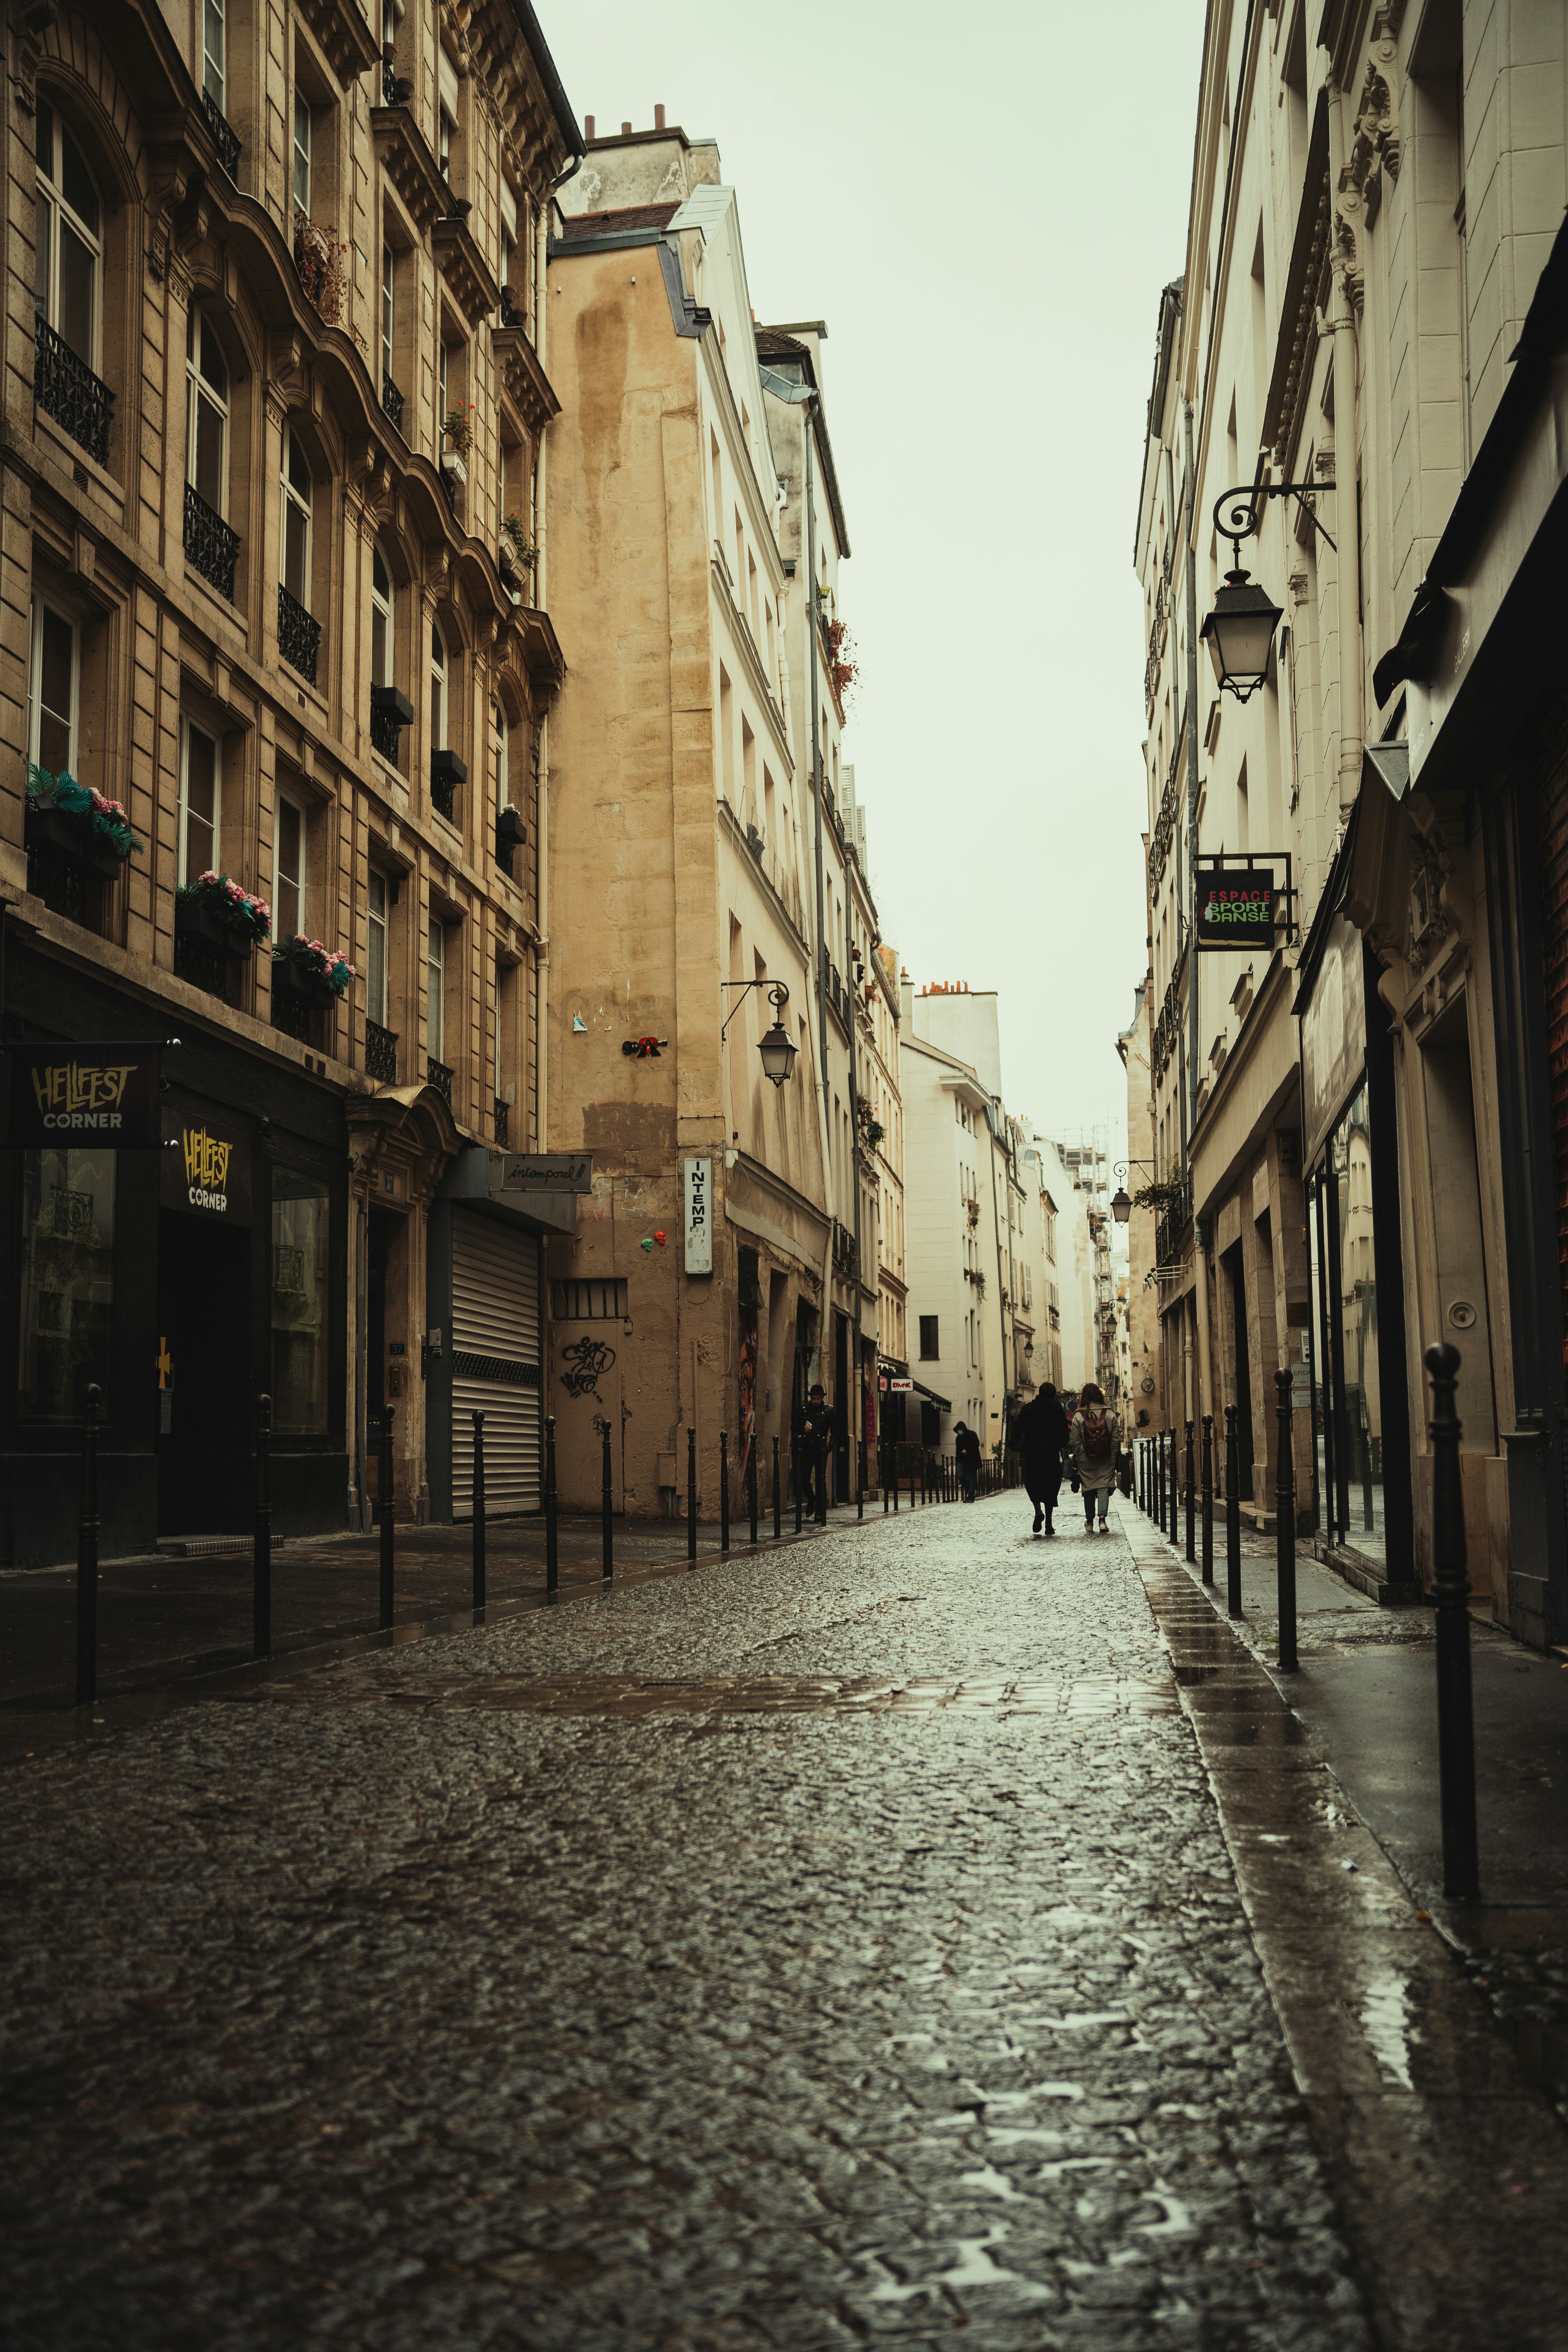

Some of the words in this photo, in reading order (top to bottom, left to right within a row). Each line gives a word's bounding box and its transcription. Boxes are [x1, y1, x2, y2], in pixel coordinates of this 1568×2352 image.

[1454, 626, 1470, 673] GALLERY
[1209, 891, 1270, 902] ESPACE
[1210, 902, 1269, 913] SPORT
[1209, 912, 1269, 922] DANSE
[31, 1060, 138, 1115] HELLFEST
[43, 1113, 122, 1128] CORNER
[183, 1126, 233, 1193] HELLFEST
[387, 1175, 393, 1191] 37
[506, 1164, 577, 1185] intemporel
[189, 1186, 227, 1212] CORNER
[692, 1161, 705, 1227] INTEMP
[392, 1345, 402, 1354] 37
